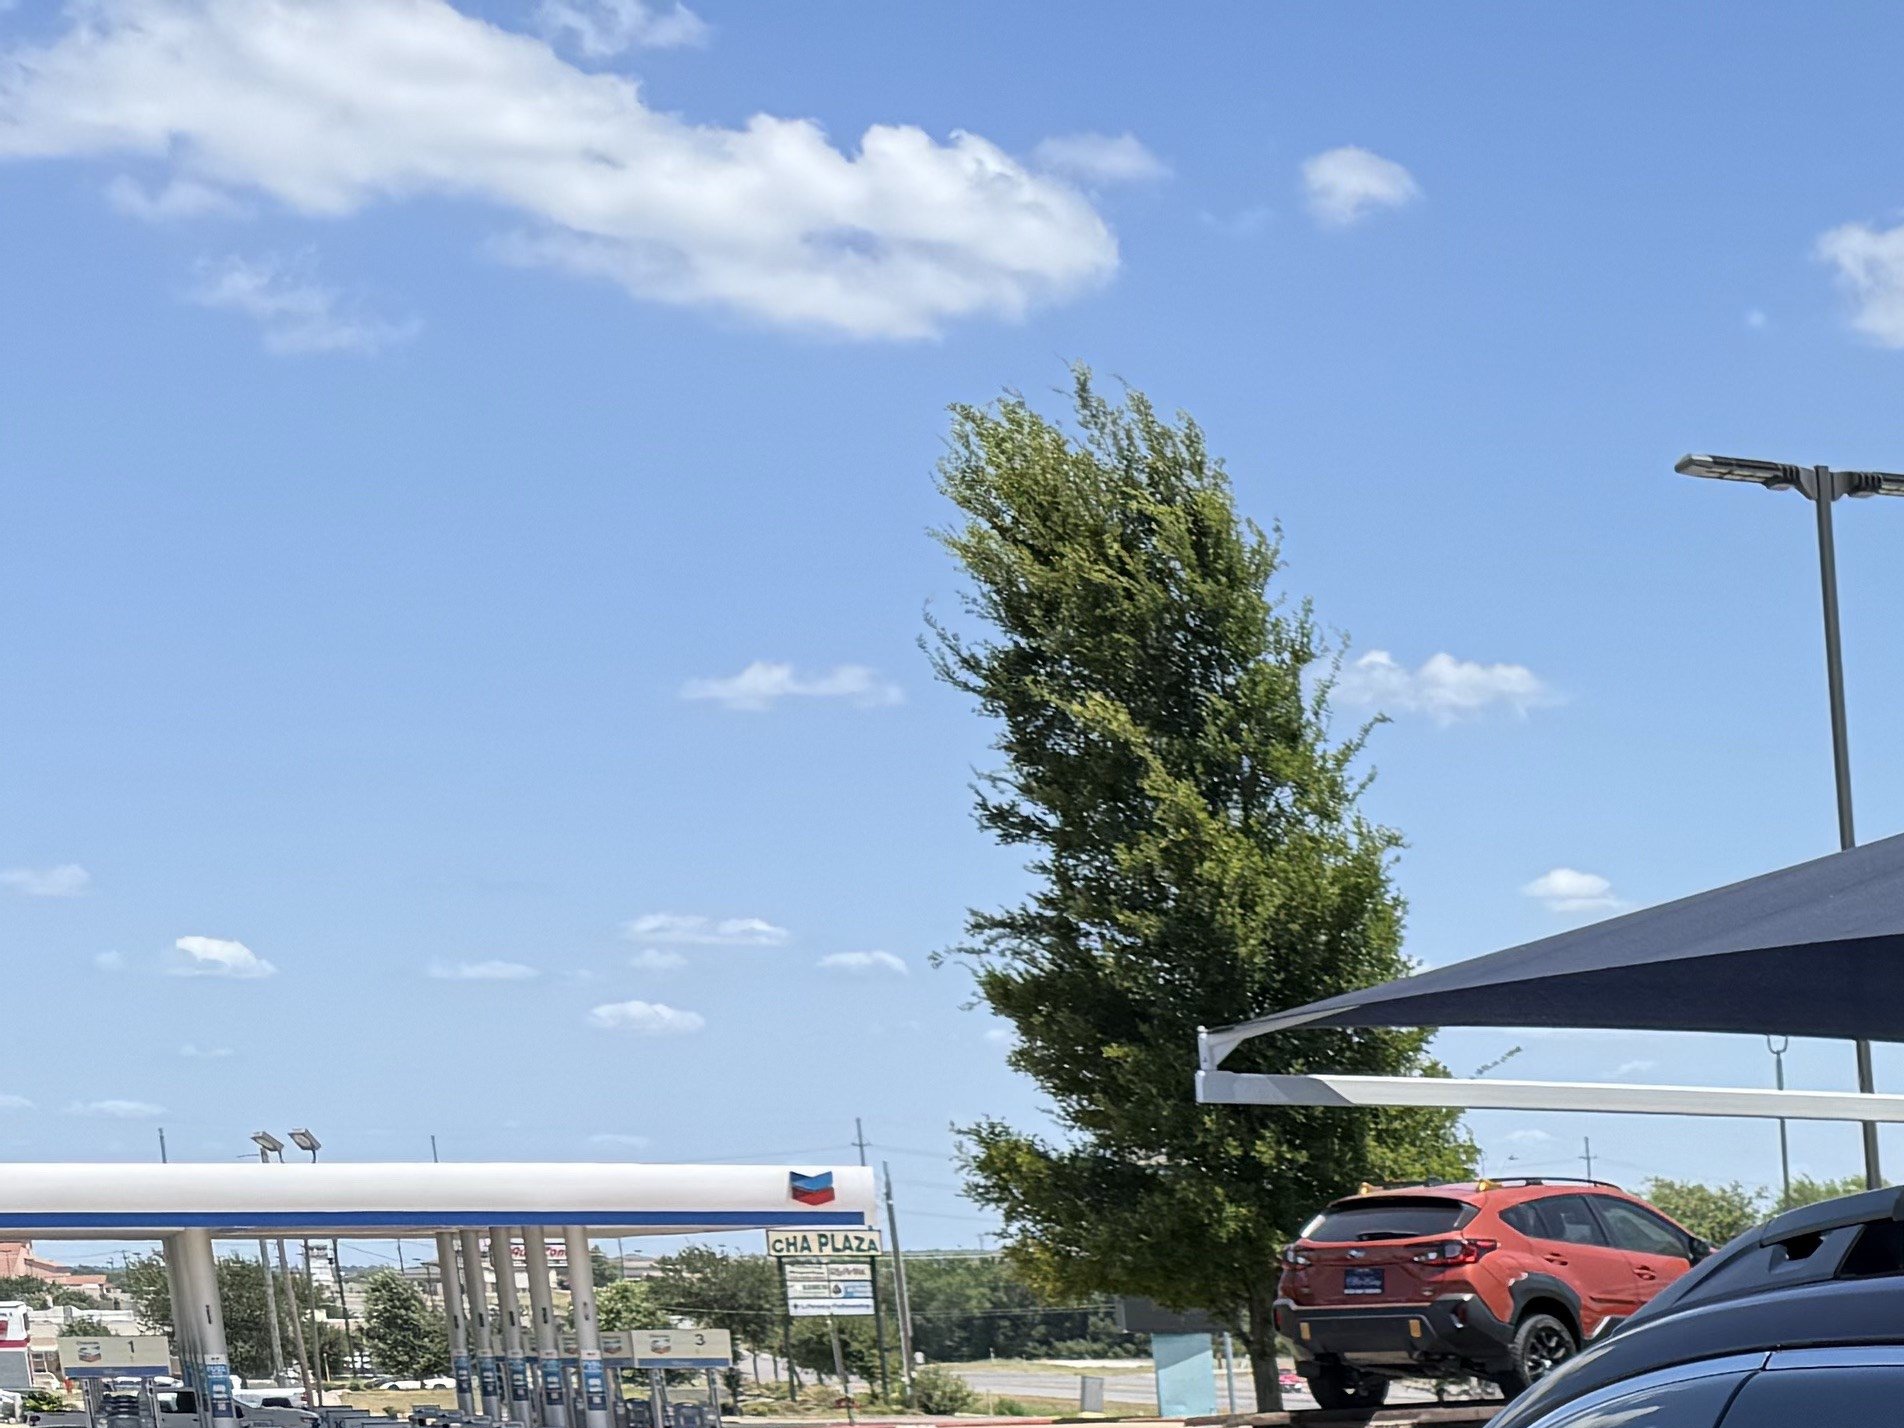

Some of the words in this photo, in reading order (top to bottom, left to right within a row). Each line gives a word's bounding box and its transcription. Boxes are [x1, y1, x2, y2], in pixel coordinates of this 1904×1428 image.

[772, 1235, 812, 1253] CHA
[817, 1233, 879, 1253] PLAZA
[128, 1340, 135, 1353] 1
[694, 1334, 706, 1346] 3
